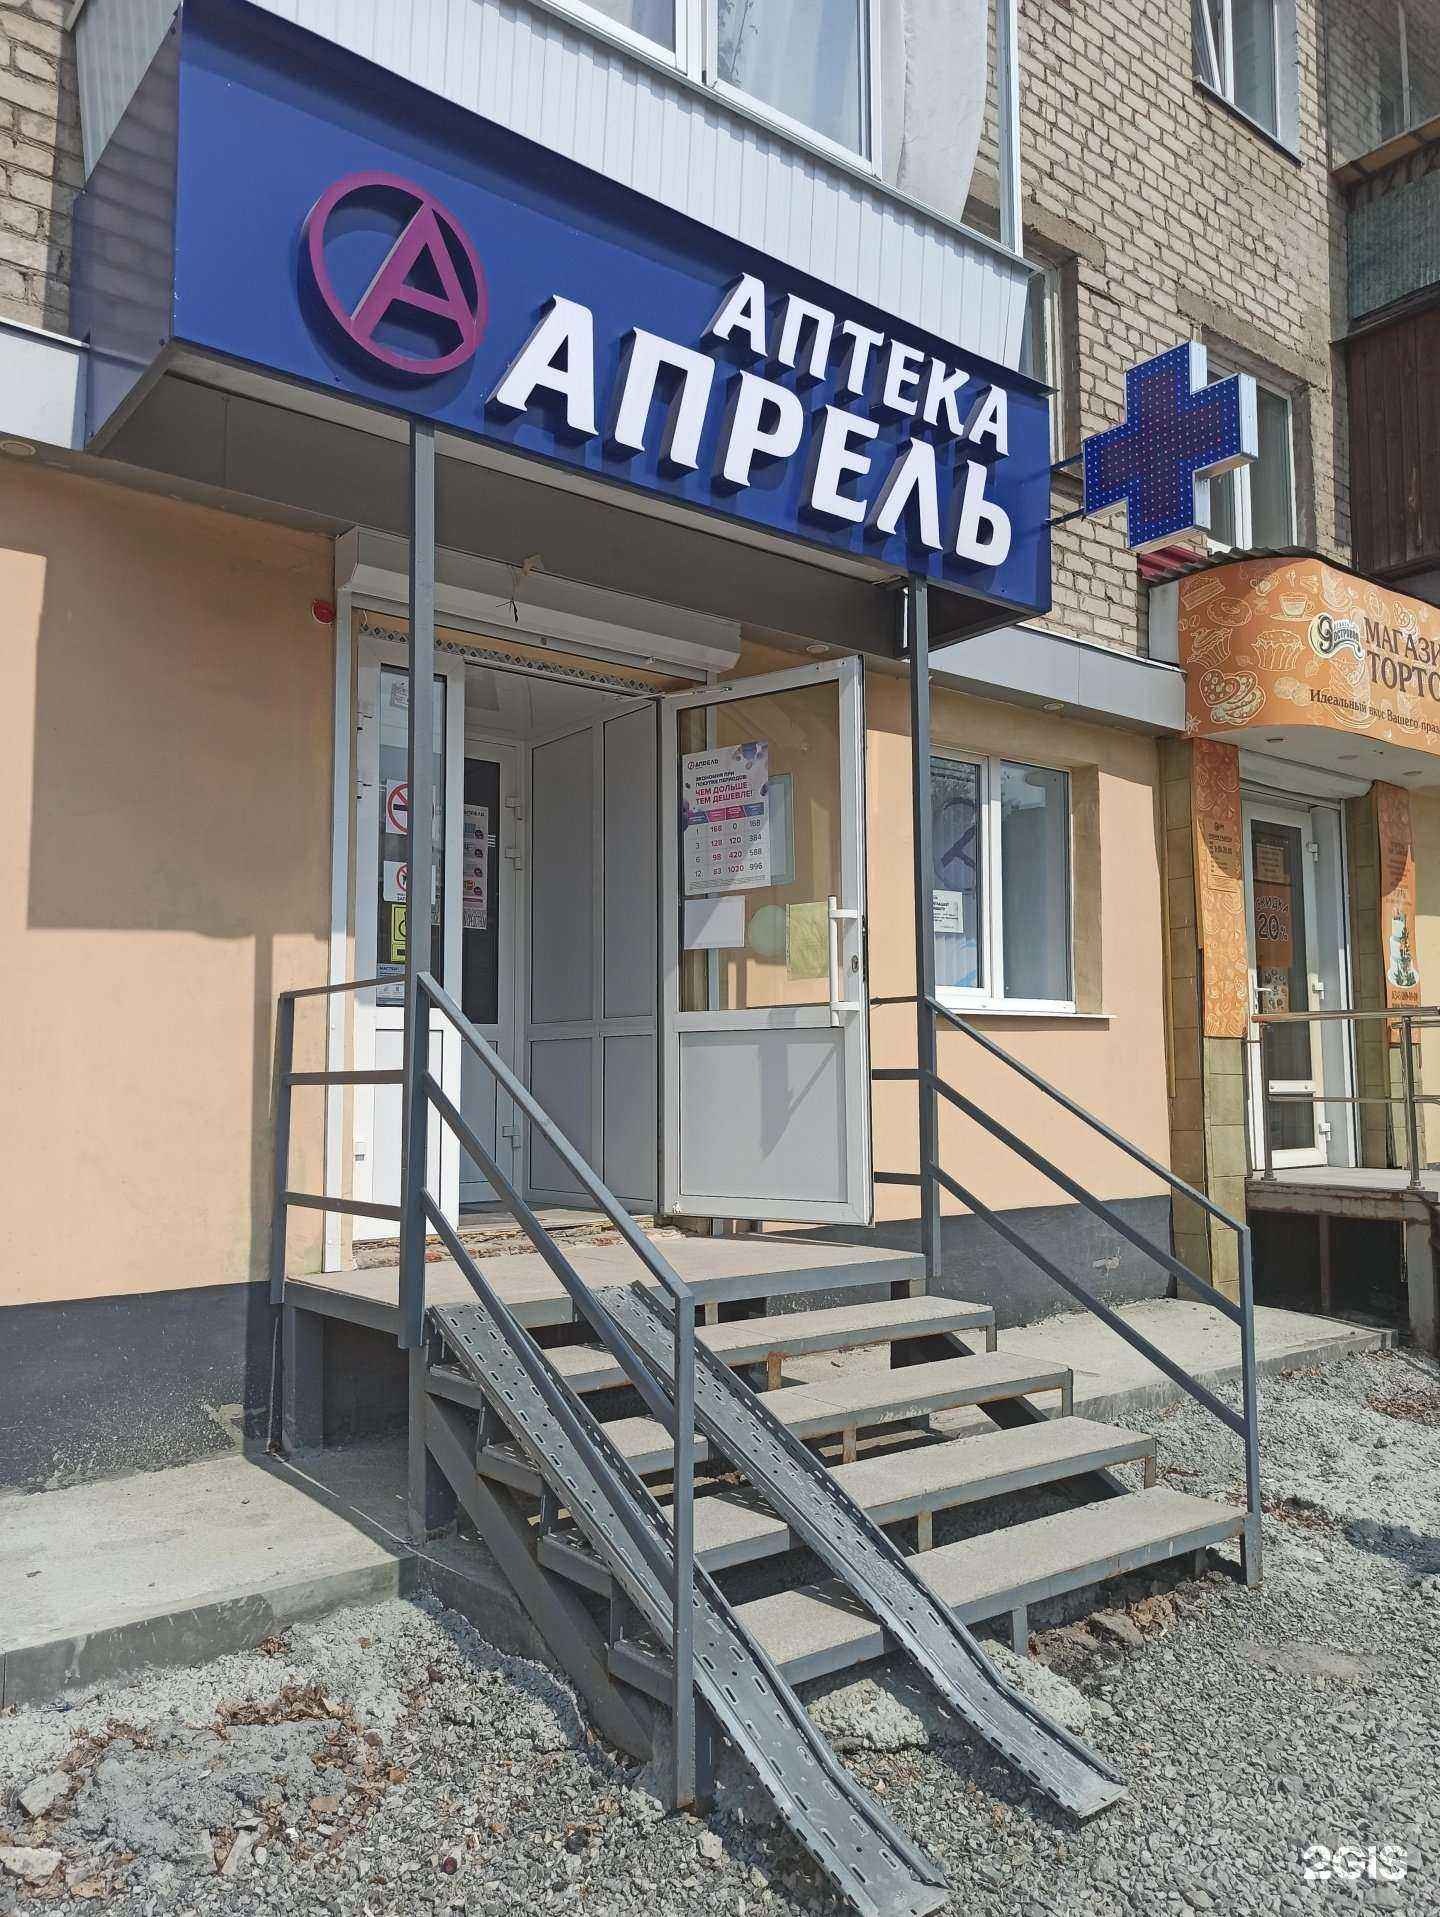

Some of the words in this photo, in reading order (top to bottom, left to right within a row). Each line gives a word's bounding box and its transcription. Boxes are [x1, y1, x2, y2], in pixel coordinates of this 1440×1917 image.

[711, 272, 1010, 457] АПТЕКА
[495, 294, 1012, 568] АПРЕЛЬ
[1310, 689, 1367, 713] Идеальный
[1369, 707, 1387, 720] вкус
[1387, 709, 1419, 728] Вашего
[695, 787, 711, 796] ЧЕМ
[712, 782, 748, 795] ДОЛЬШЕ
[695, 796, 711, 805] ТЕМ
[712, 790, 753, 804] ДЕШЕВЛЕ!
[732, 822, 738, 831] 0
[729, 836, 742, 844] 120
[728, 851, 743, 859] 420
[727, 865, 745, 873] 1020
